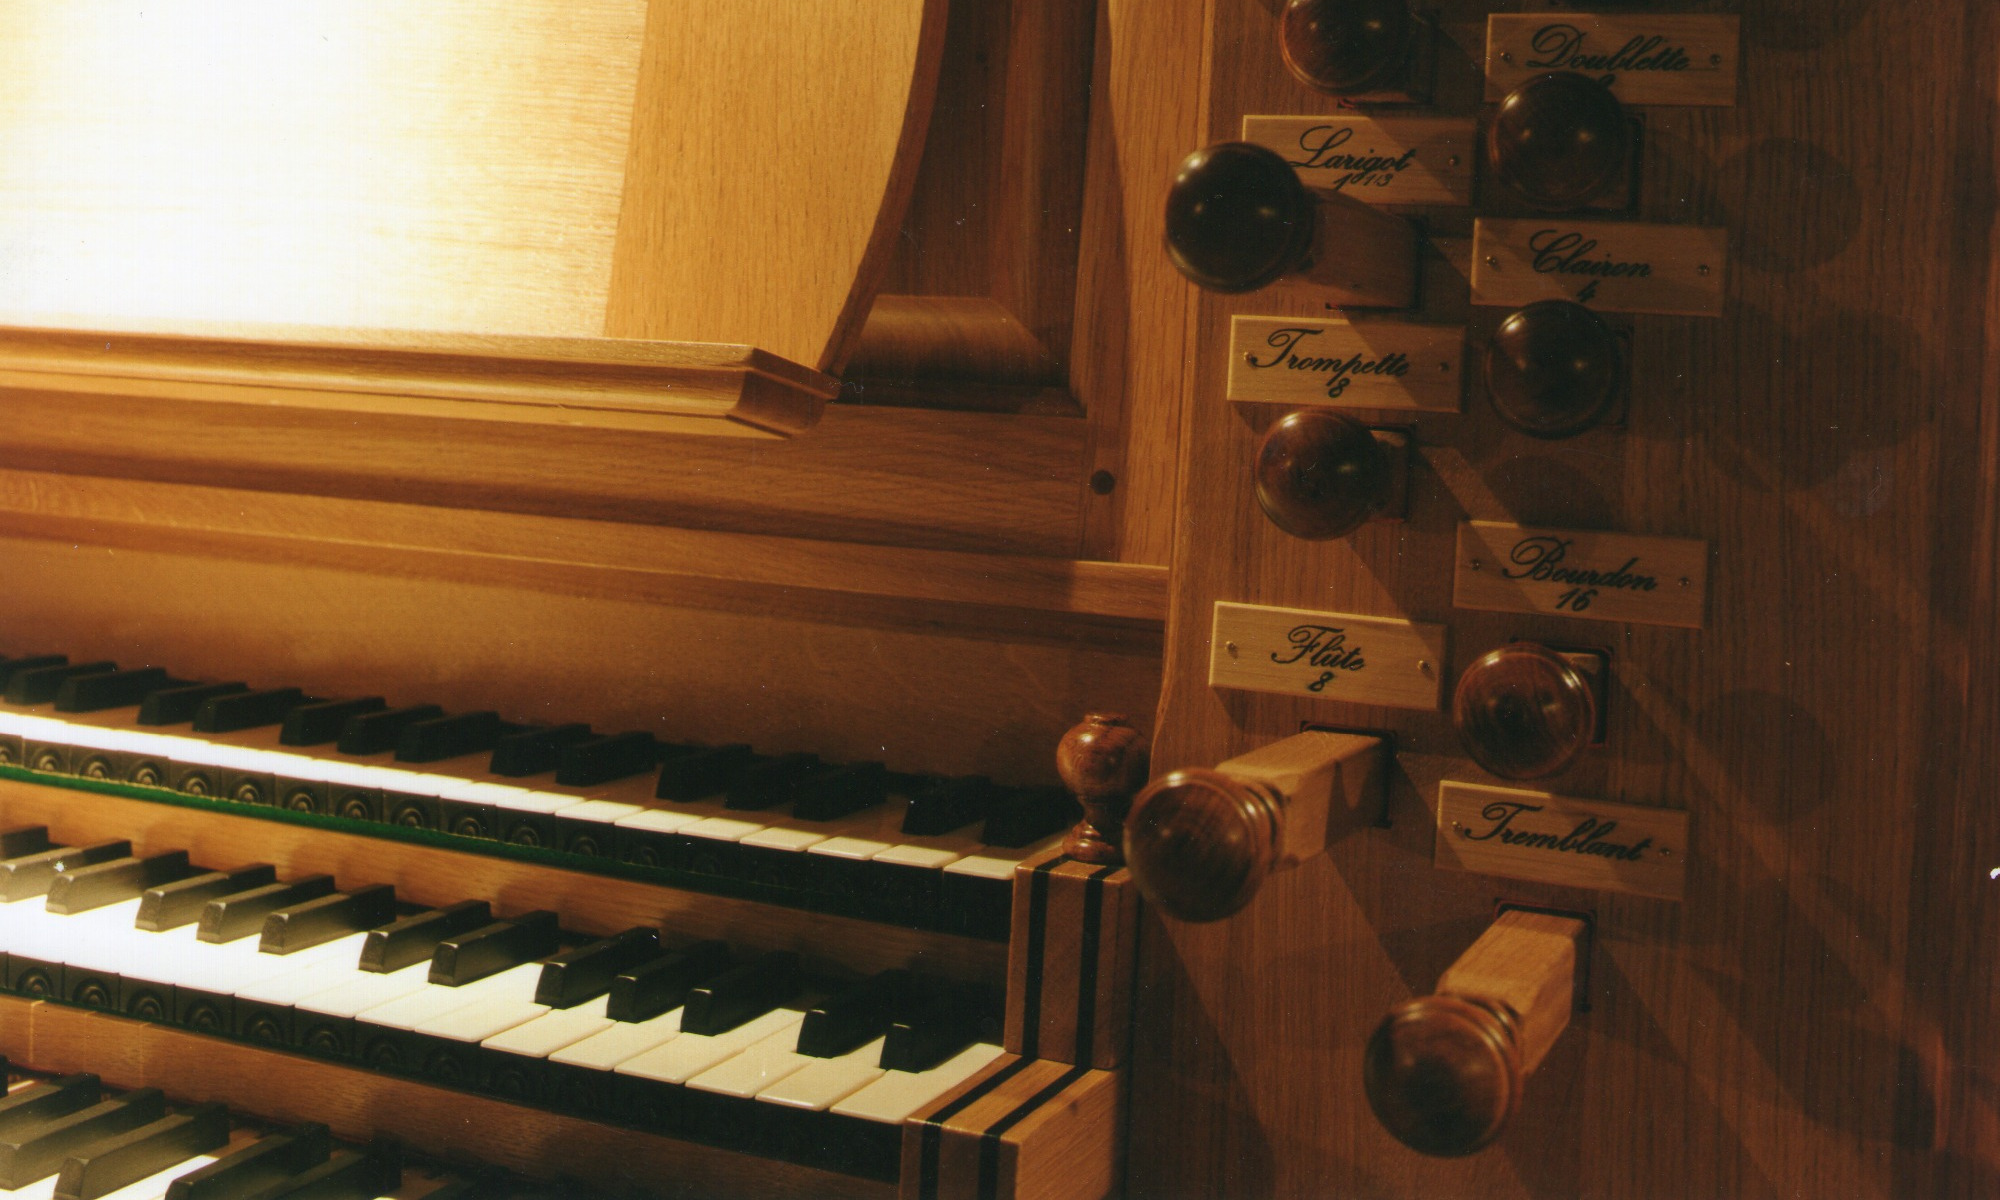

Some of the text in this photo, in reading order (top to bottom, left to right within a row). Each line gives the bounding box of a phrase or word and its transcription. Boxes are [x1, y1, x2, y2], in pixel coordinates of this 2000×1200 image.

[1526, 24, 1690, 71] Doublette
[1289, 125, 1417, 183] Larigot
[1529, 229, 1653, 277] Clairon
[1577, 280, 1600, 303] 4
[1250, 328, 1410, 386] Trompette
[1328, 377, 1351, 398] 8
[1502, 537, 1657, 591] Bourdon
[1556, 587, 1598, 611] 16
[1271, 625, 1365, 671] Flûte
[1308, 671, 1334, 691] 8
[1464, 802, 1653, 861] Tremblant
